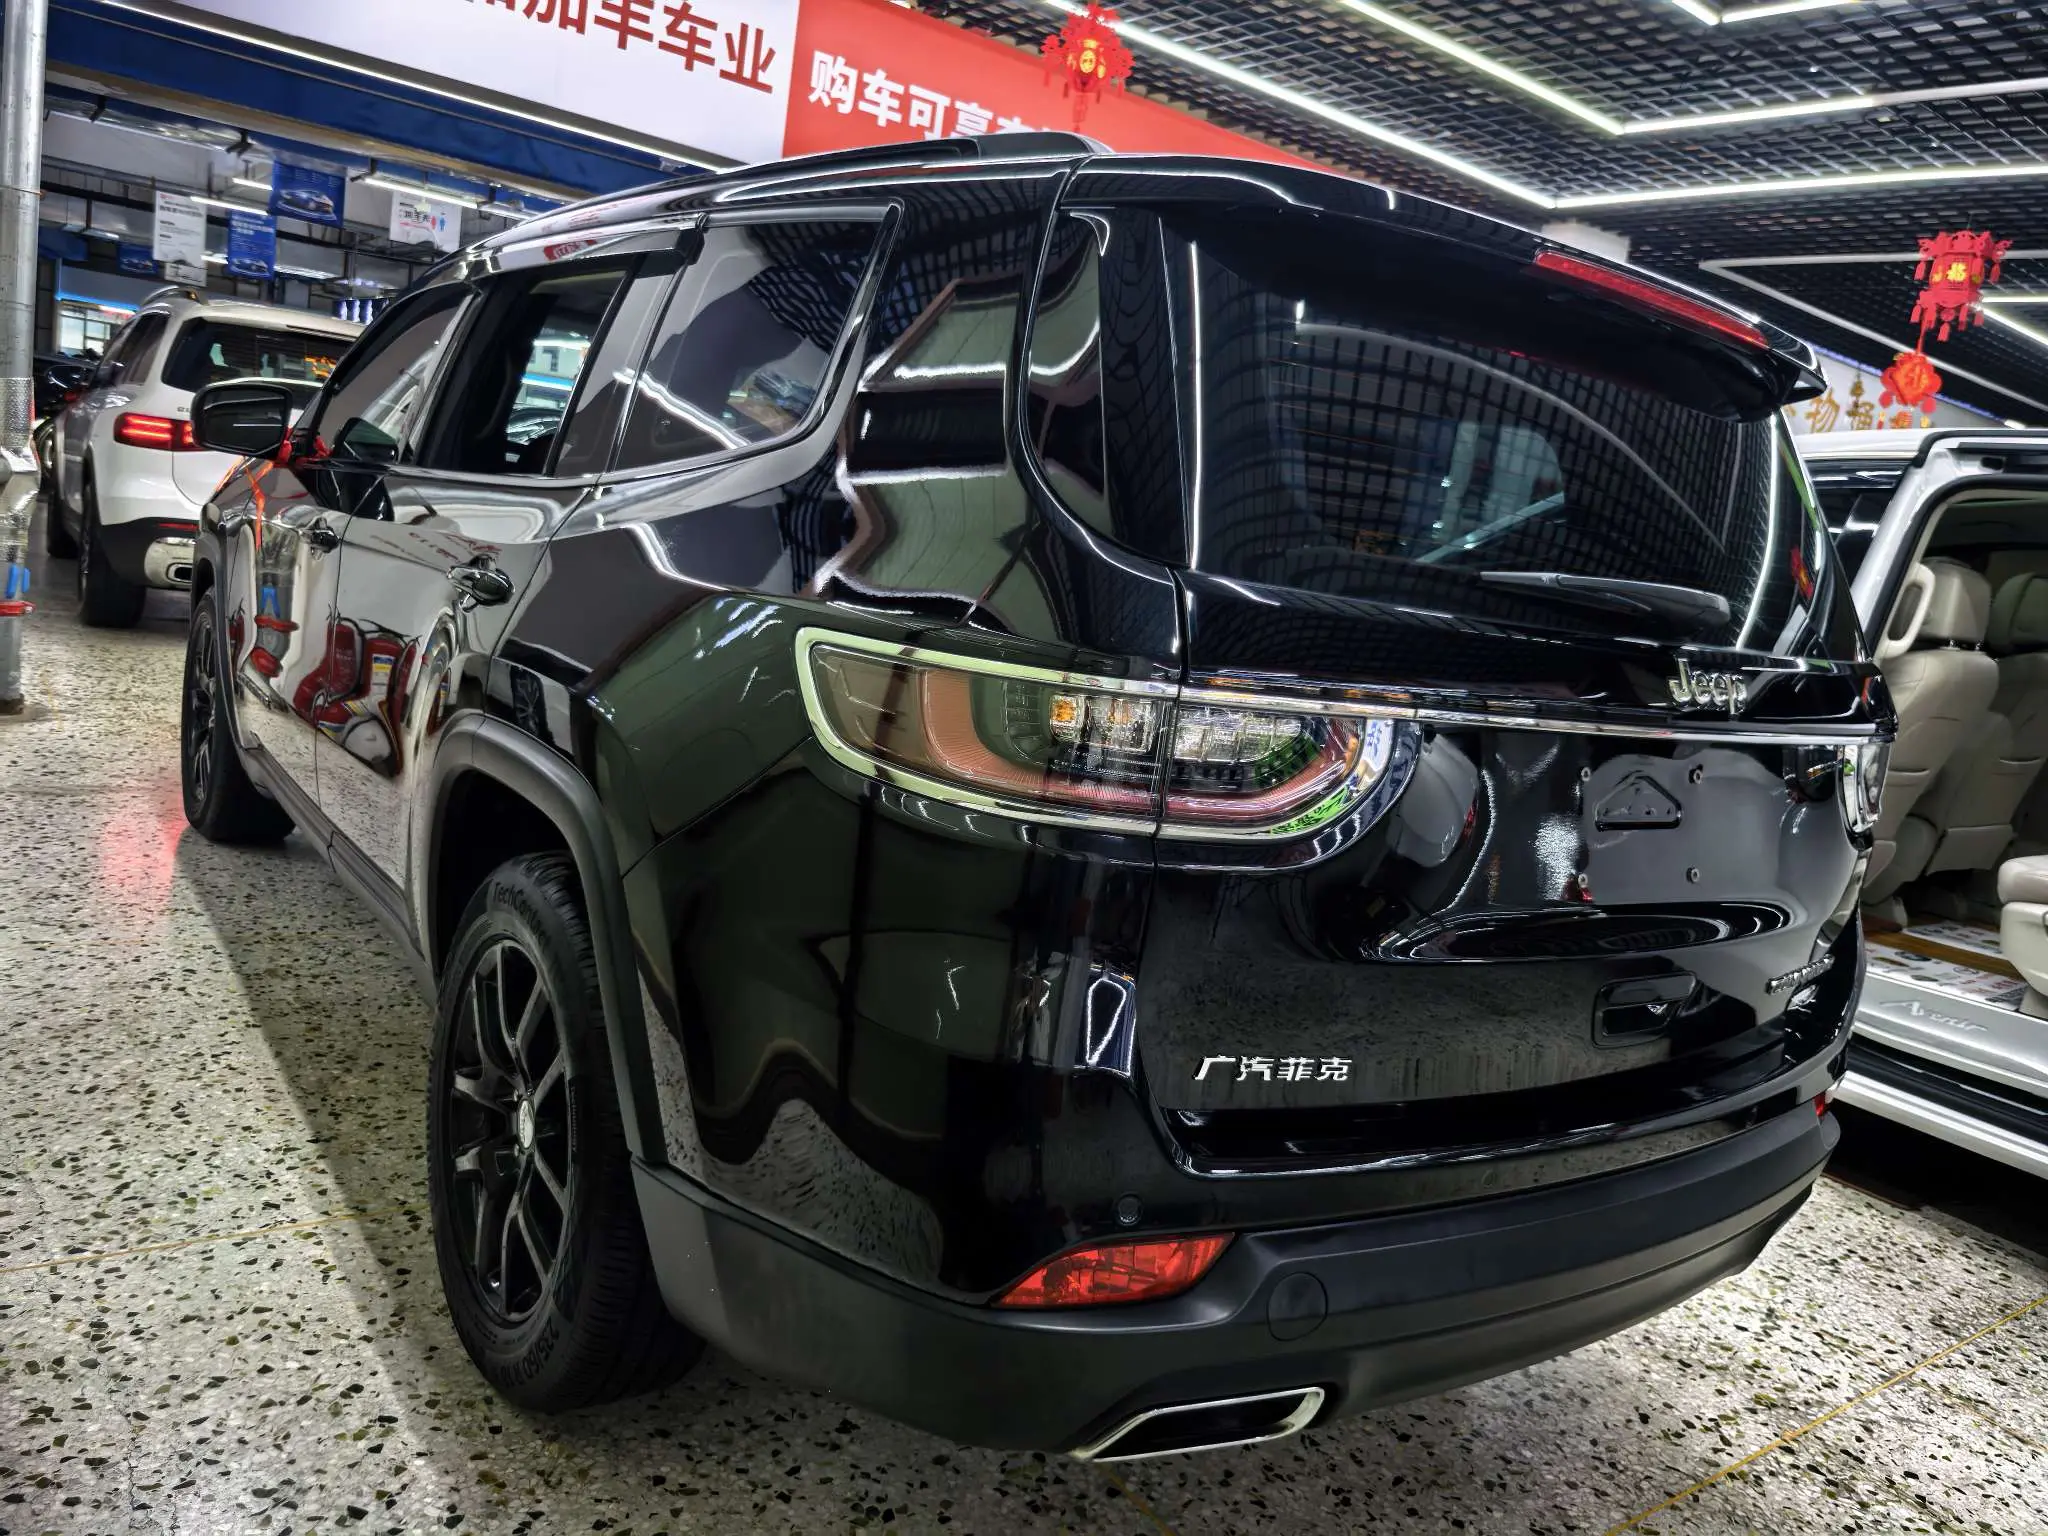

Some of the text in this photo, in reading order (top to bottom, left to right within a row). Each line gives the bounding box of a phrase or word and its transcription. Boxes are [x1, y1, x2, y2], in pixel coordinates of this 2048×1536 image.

[1668, 657, 1747, 715] Jeep
[1192, 1054, 1353, 1082] 广汽菲克
